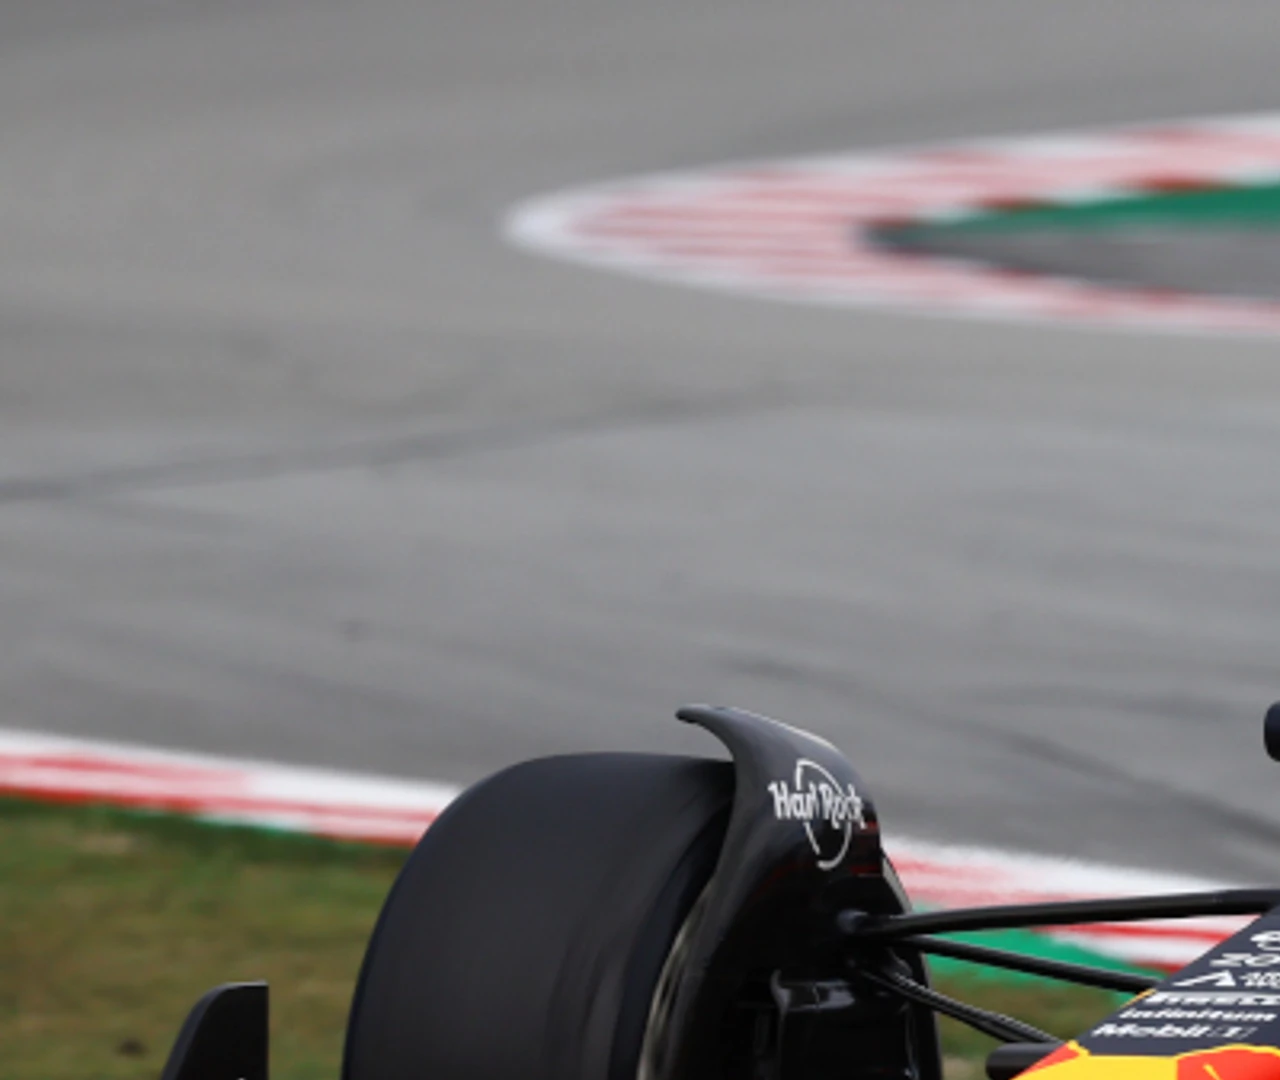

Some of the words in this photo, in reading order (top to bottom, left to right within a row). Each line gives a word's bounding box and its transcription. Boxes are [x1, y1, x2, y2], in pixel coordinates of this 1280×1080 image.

[767, 780, 817, 820] Hard
[819, 783, 868, 830] Rock
[1090, 1023, 1211, 1039] Mobil
